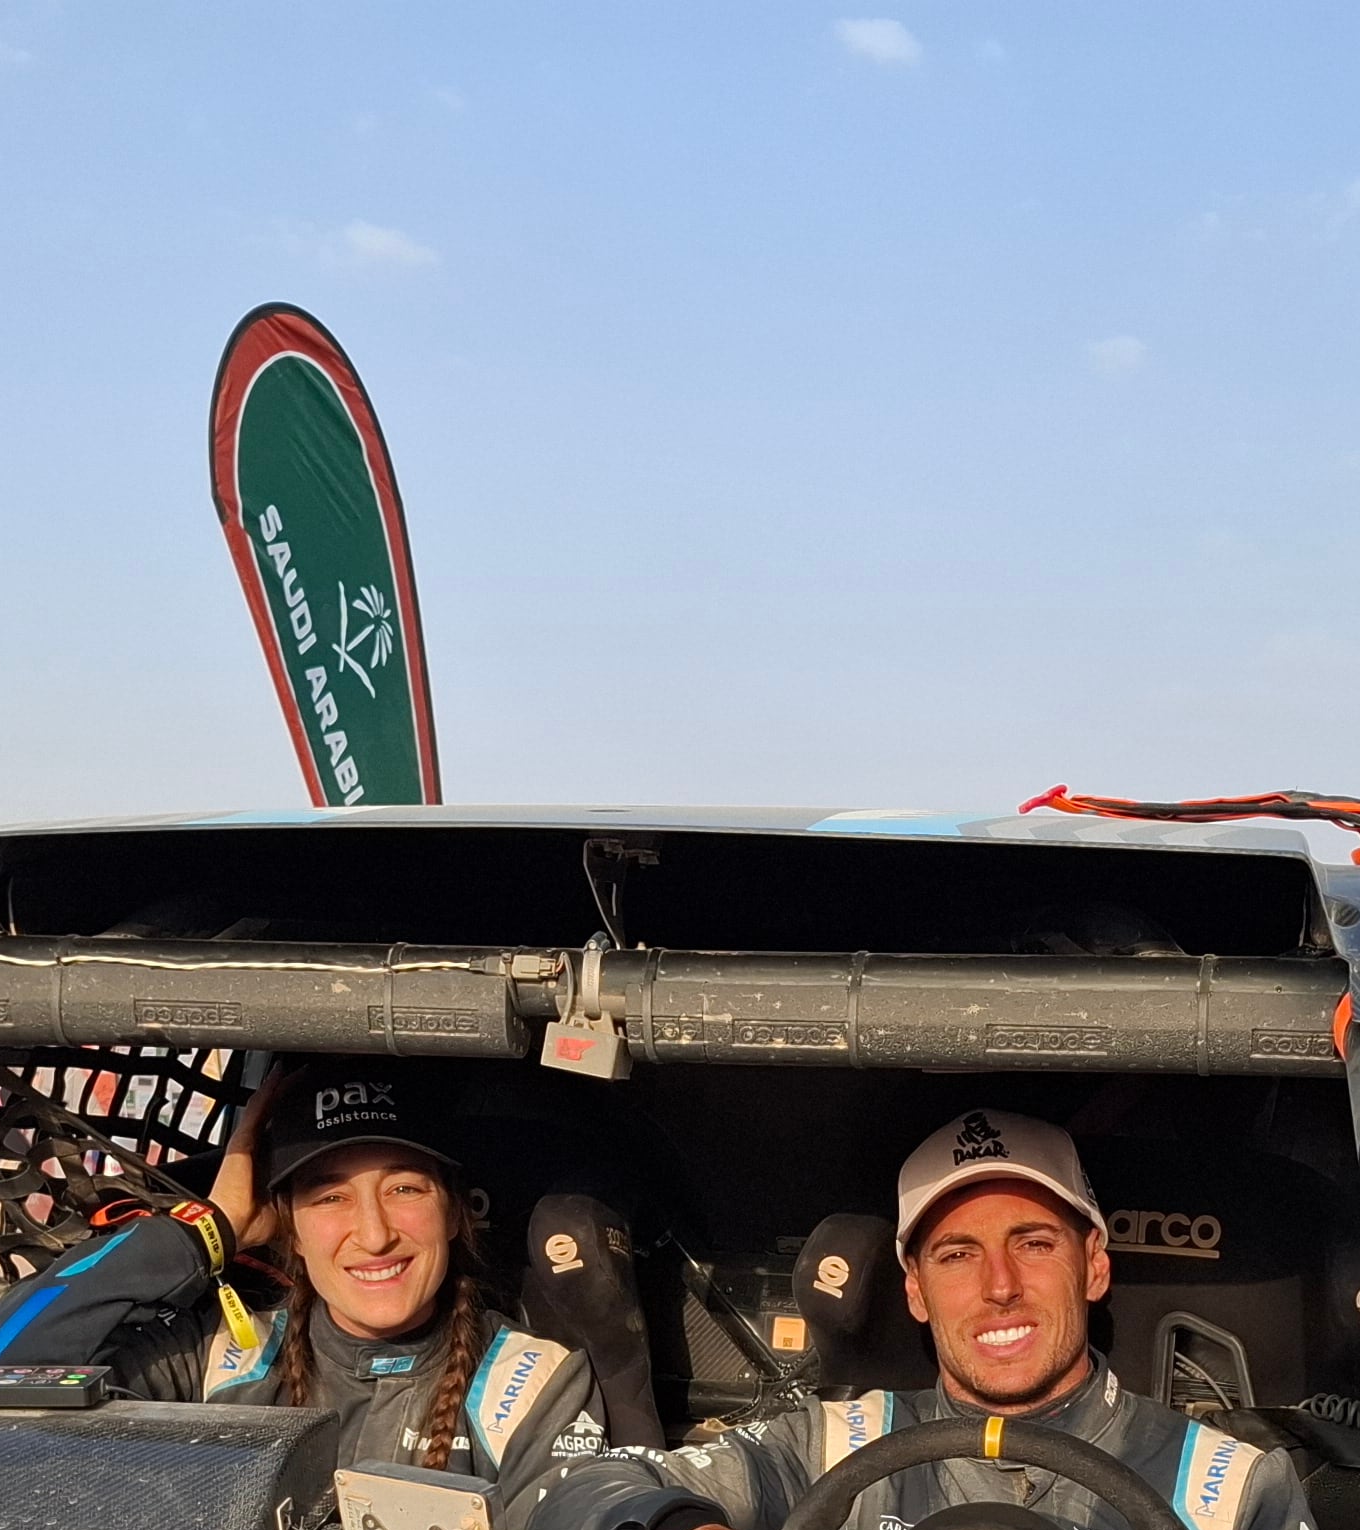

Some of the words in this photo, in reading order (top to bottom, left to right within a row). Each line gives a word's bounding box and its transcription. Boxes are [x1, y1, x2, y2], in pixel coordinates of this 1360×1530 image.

[259, 504, 318, 656] SAUDI
[305, 665, 365, 806] ARABI
[315, 1081, 396, 1121] pax
[316, 1110, 398, 1130] assistance
[952, 1139, 1009, 1166] DAKAR
[1106, 1209, 1222, 1249] arco
[486, 1349, 543, 1434] MARINA
[846, 1401, 867, 1451] ARIN
[1194, 1438, 1240, 1518] MARINA
